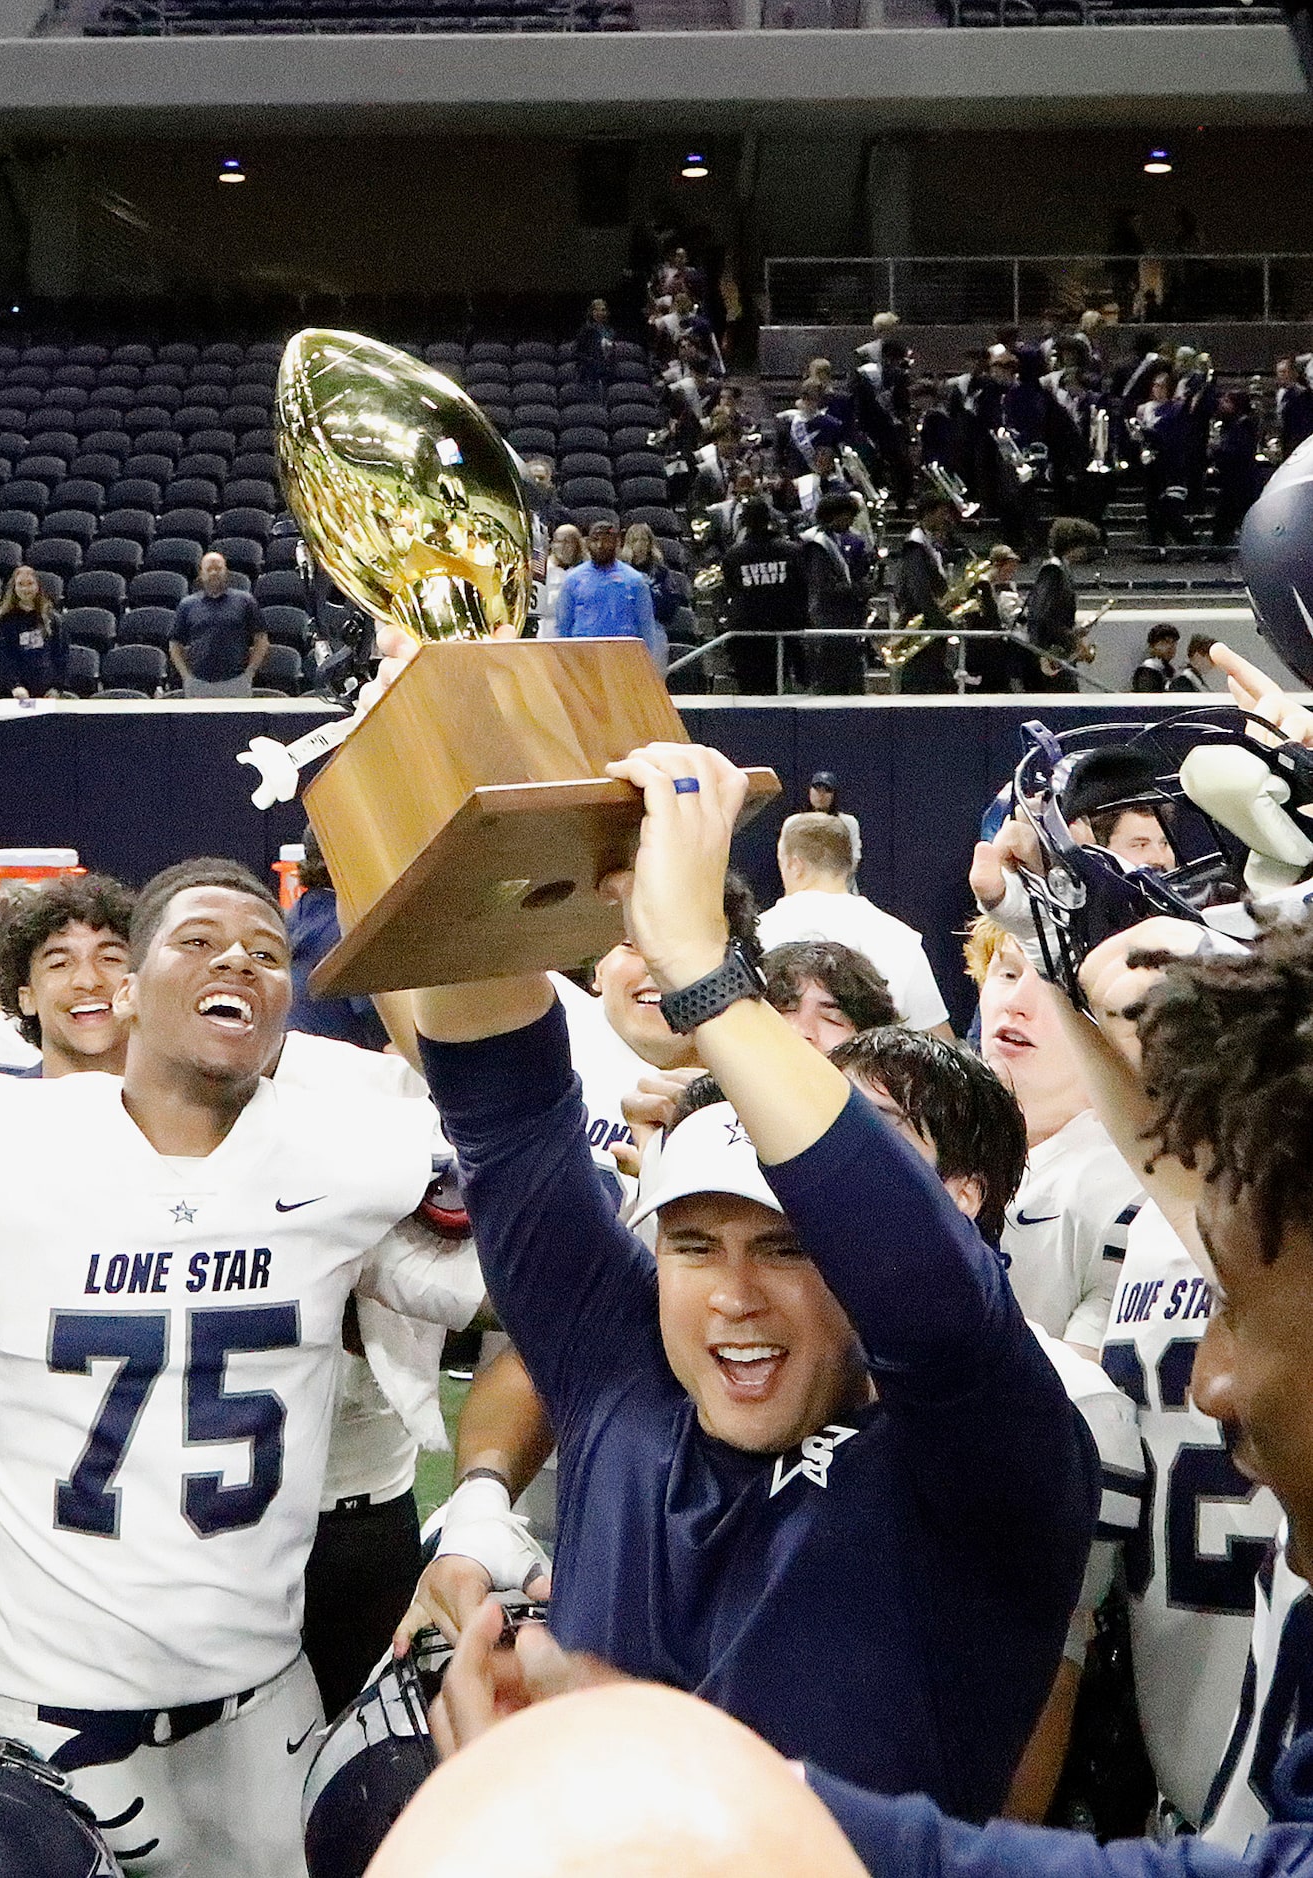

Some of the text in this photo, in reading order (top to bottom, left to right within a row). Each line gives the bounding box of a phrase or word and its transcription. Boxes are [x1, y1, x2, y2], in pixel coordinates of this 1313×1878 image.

[740, 561, 787, 577] EVENT
[742, 572, 787, 587] STAFF
[84, 1247, 272, 1294] LONE STAR
[1116, 1279, 1163, 1324] LONE
[46, 1299, 302, 1540] 75
